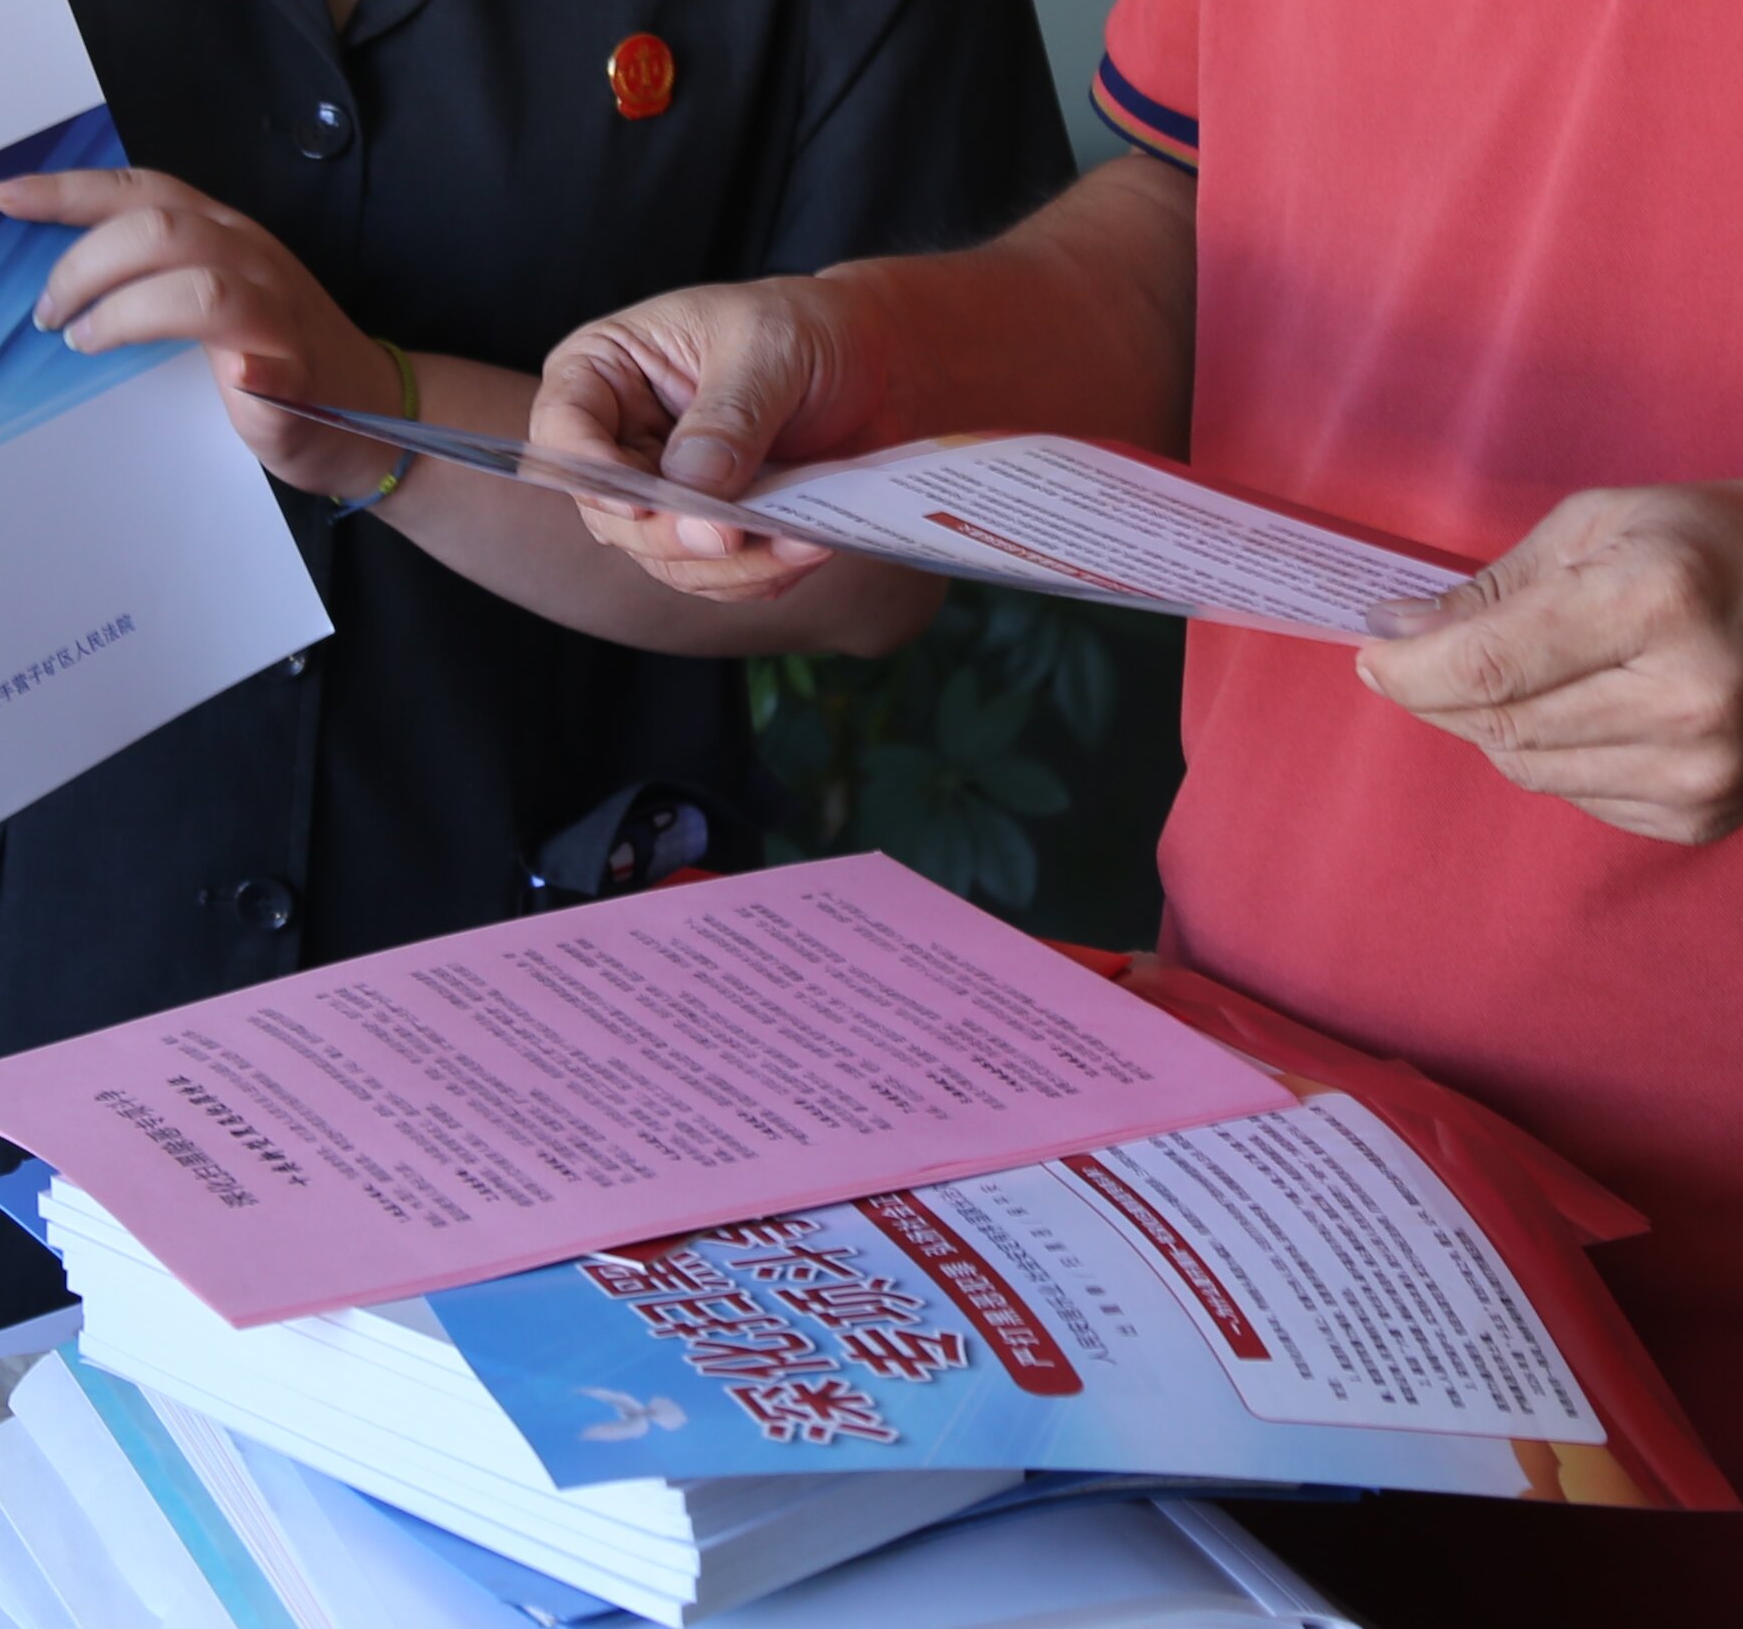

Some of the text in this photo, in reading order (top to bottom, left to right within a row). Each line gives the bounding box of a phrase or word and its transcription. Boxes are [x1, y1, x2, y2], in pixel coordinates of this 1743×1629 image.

[94, 1089, 260, 1210] 深化扫黑除恶专项斗争
[576, 1251, 903, 1443] 深化扫黑
[939, 1260, 1056, 1367] 严打黑恶犯罪
